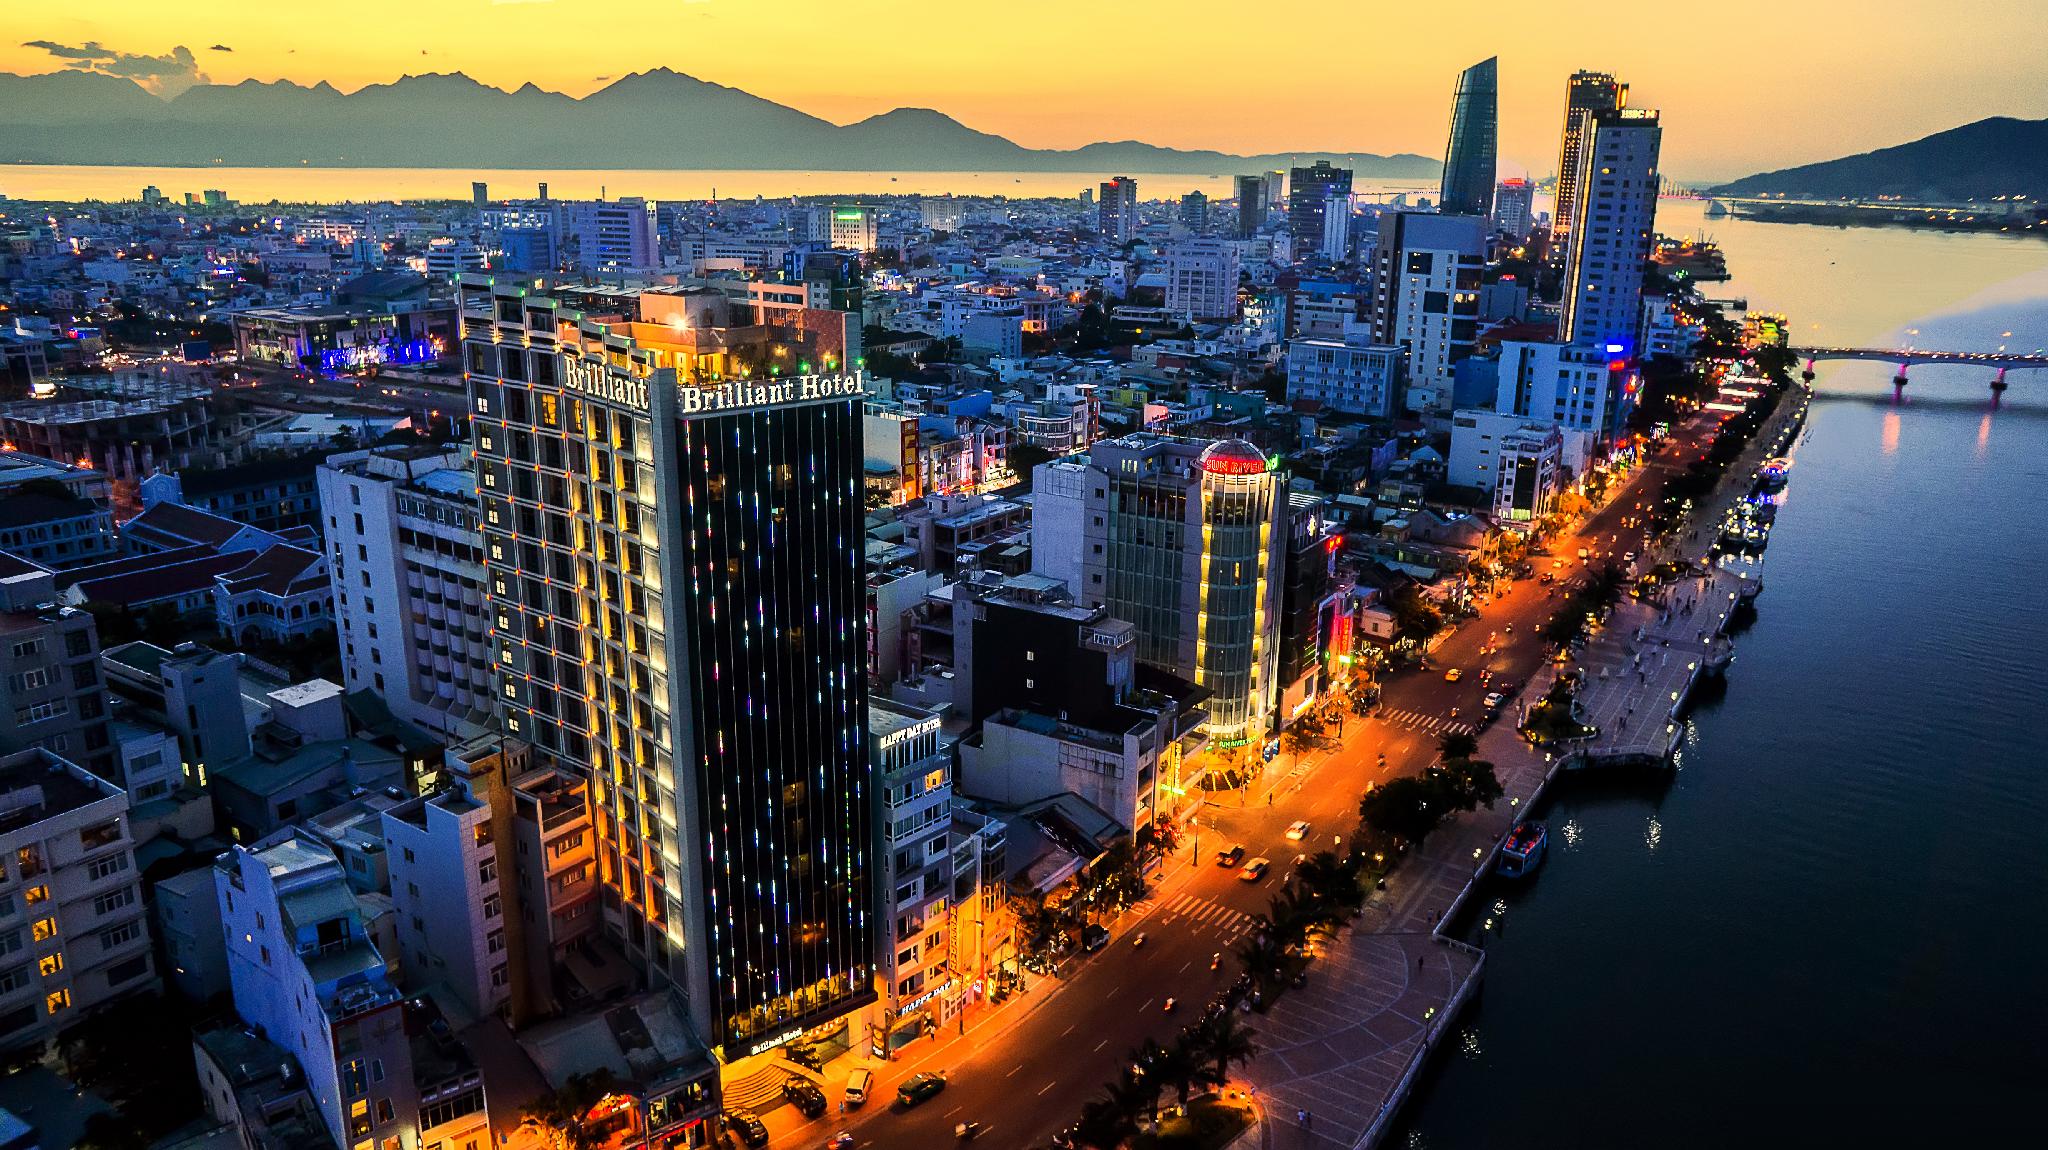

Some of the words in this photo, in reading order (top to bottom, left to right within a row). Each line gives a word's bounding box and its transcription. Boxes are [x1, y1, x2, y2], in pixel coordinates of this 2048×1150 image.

[564, 355, 649, 410] Brilliant
[682, 379, 794, 414] Brilliant
[799, 369, 864, 400] Hotel
[1206, 459, 1228, 472] SUN
[1230, 461, 1265, 473] RIVER
[880, 729, 906, 750] HAPPY
[906, 723, 921, 739] DAY
[921, 717, 941, 733] HOTEL
[901, 991, 932, 1015] HAPPY
[932, 981, 951, 997] DAY
